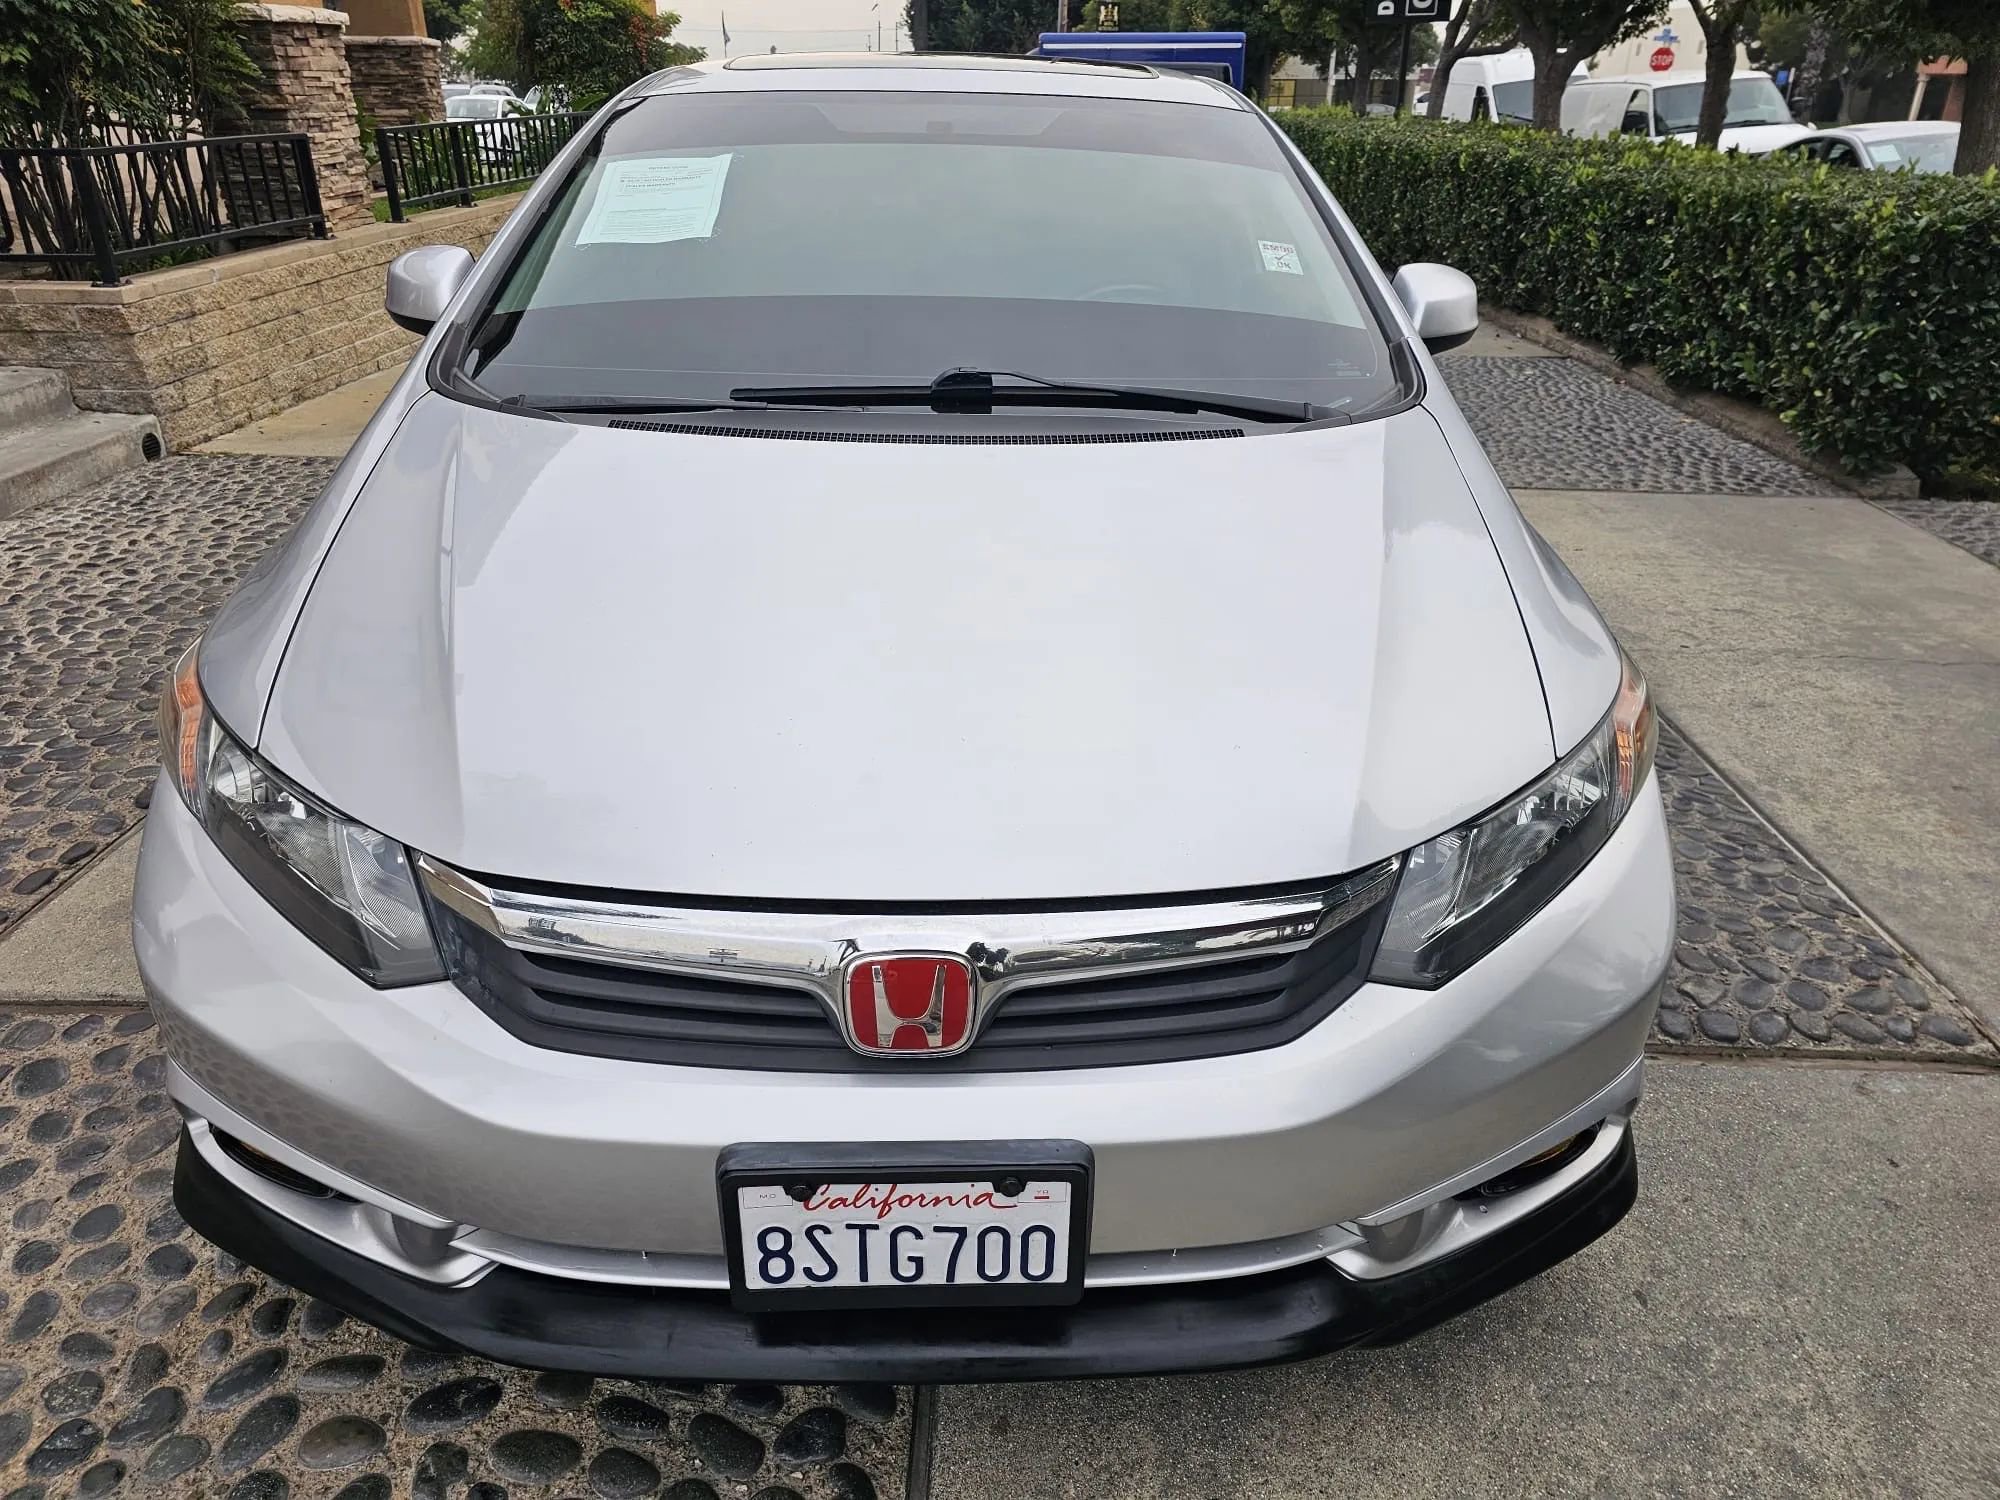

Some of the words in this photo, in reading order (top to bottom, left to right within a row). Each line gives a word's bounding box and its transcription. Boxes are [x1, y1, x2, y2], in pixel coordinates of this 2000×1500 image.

[1651, 54, 1673, 66] STOP
[802, 1182, 1018, 1220] California
[756, 1223, 1057, 1285] 8STG700
